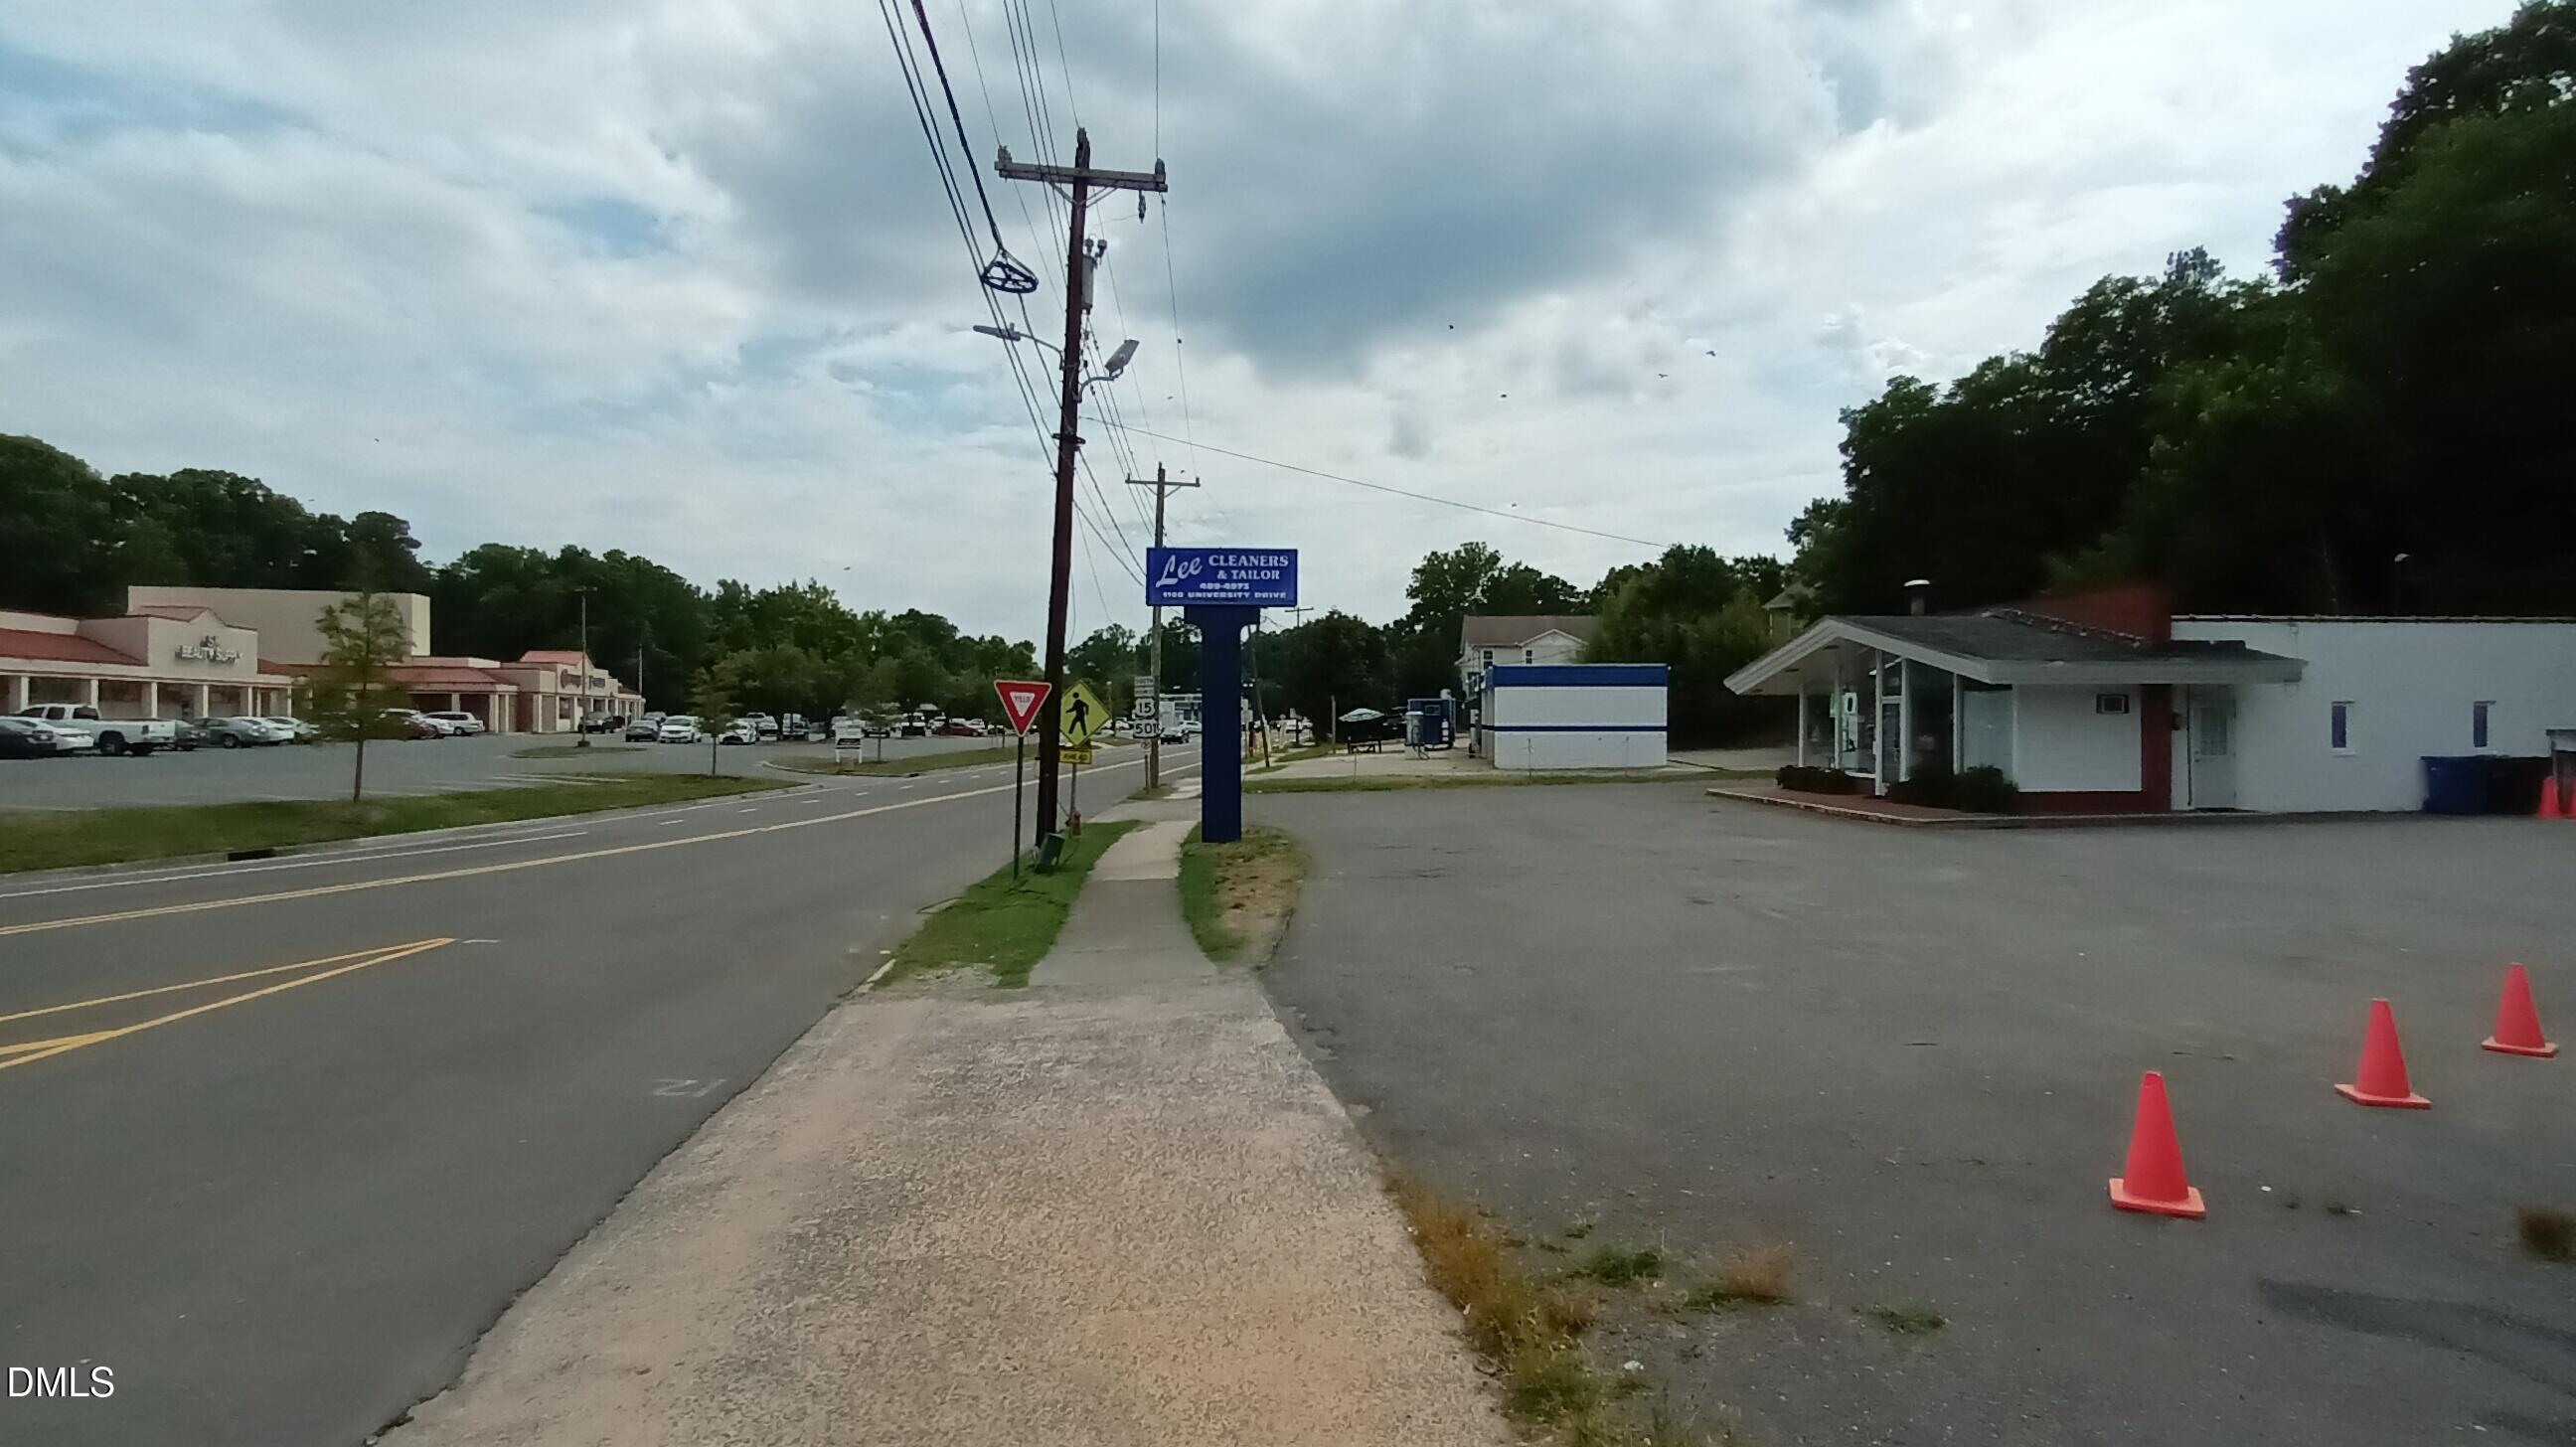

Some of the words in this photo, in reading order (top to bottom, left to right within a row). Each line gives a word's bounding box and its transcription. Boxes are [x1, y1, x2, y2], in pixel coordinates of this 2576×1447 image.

[1208, 555, 1289, 566] CLEANERS
[1156, 555, 1203, 587] Lee
[1217, 570, 1227, 579] &
[1230, 569, 1280, 579] TAILOR
[1139, 702, 1152, 714] 15
[1135, 723, 1157, 734] 501
